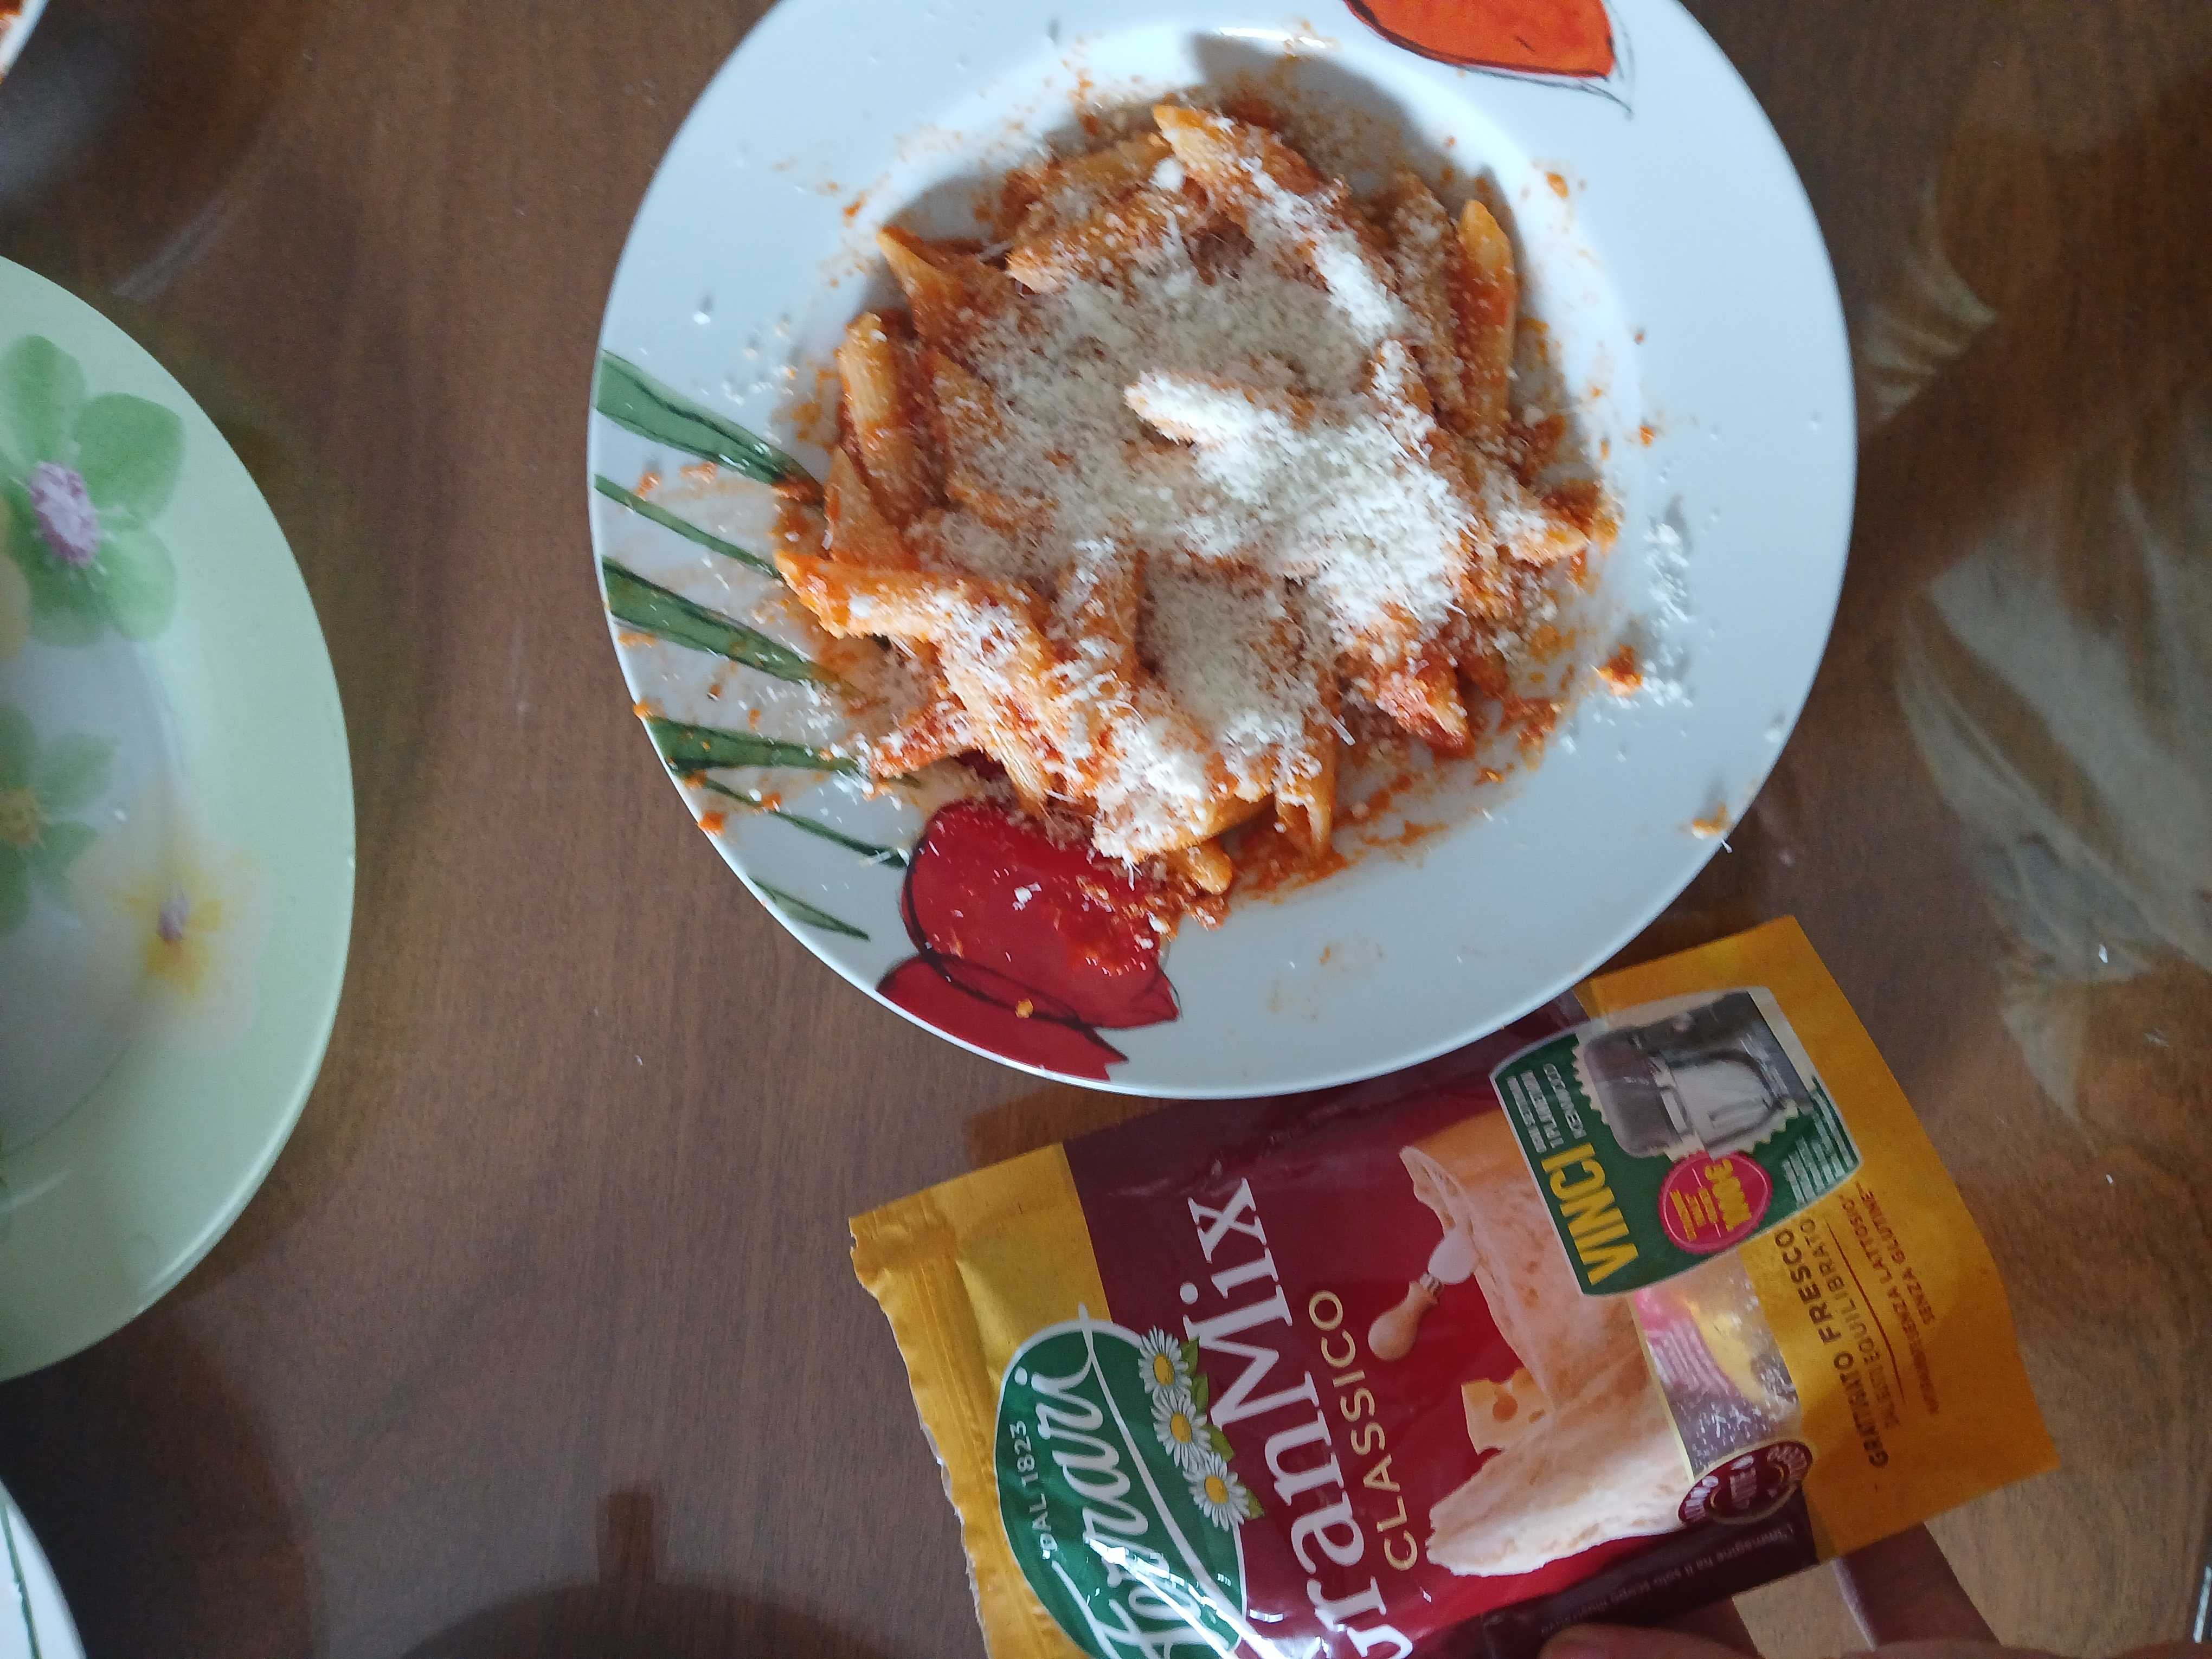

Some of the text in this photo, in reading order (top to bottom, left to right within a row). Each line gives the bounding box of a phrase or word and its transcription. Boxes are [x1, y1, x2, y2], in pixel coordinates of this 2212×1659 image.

[1541, 1142, 1639, 1286] VINCI
[1774, 1227, 1842, 1346] FRESCO
[1009, 1420, 1039, 1489] 1823
[1308, 1289, 1418, 1572] CLASSICO
